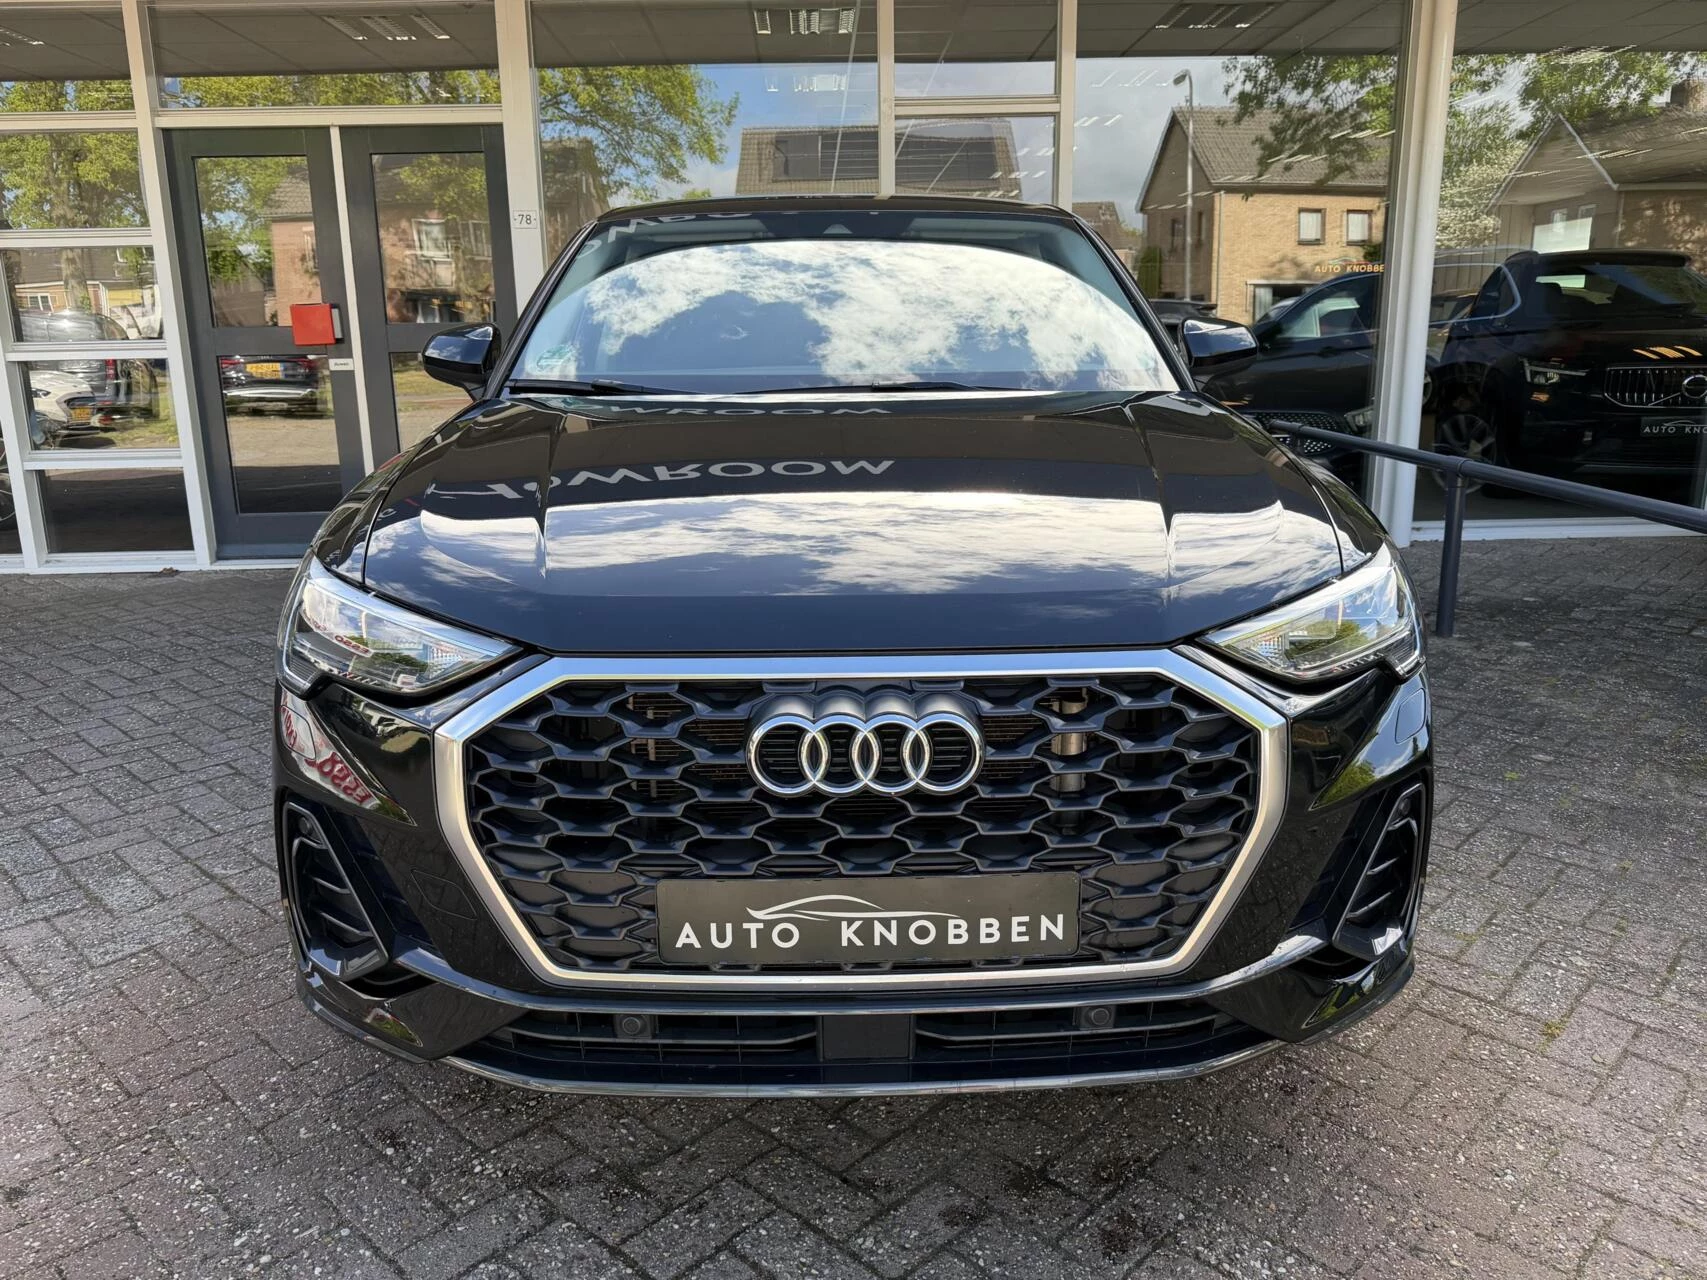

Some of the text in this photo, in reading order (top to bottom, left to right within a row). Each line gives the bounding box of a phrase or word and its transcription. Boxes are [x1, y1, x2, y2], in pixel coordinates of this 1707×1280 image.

[517, 214, 532, 225] 78
[1314, 265, 1341, 273] AUTO
[1643, 426, 1677, 434] AUTO
[675, 914, 1065, 949] AUTO KNOBBEN
